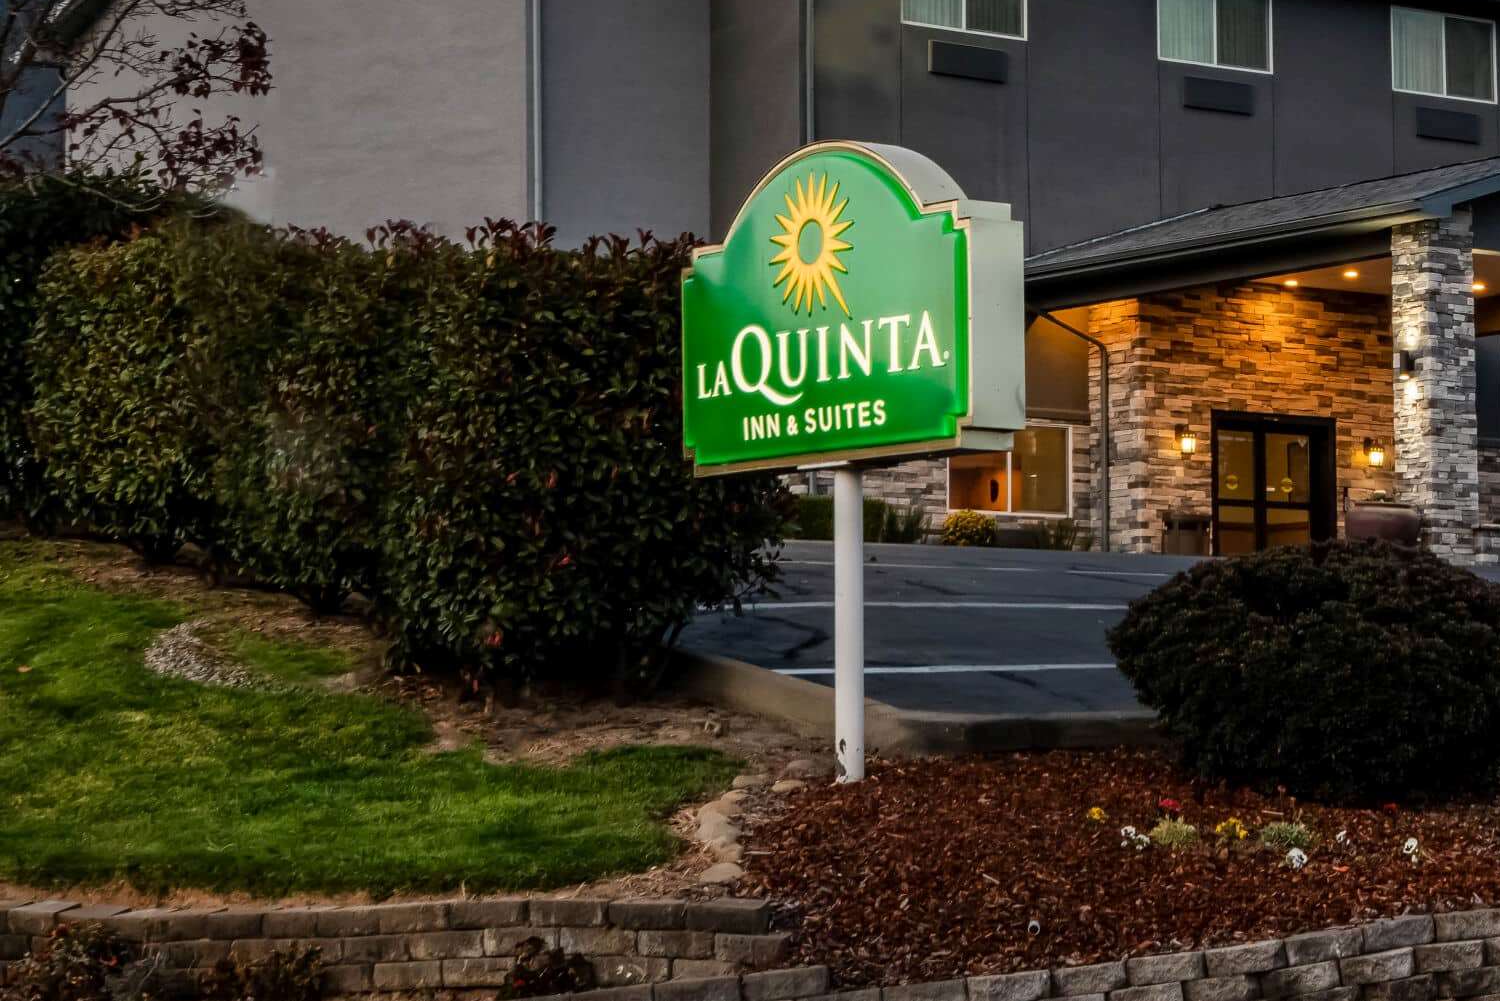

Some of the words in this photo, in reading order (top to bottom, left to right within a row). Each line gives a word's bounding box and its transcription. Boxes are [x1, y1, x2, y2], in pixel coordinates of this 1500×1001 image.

[697, 360, 733, 400] LA
[742, 412, 780, 441] INN
[787, 414, 799, 435] &
[804, 400, 887, 434] SUITES
